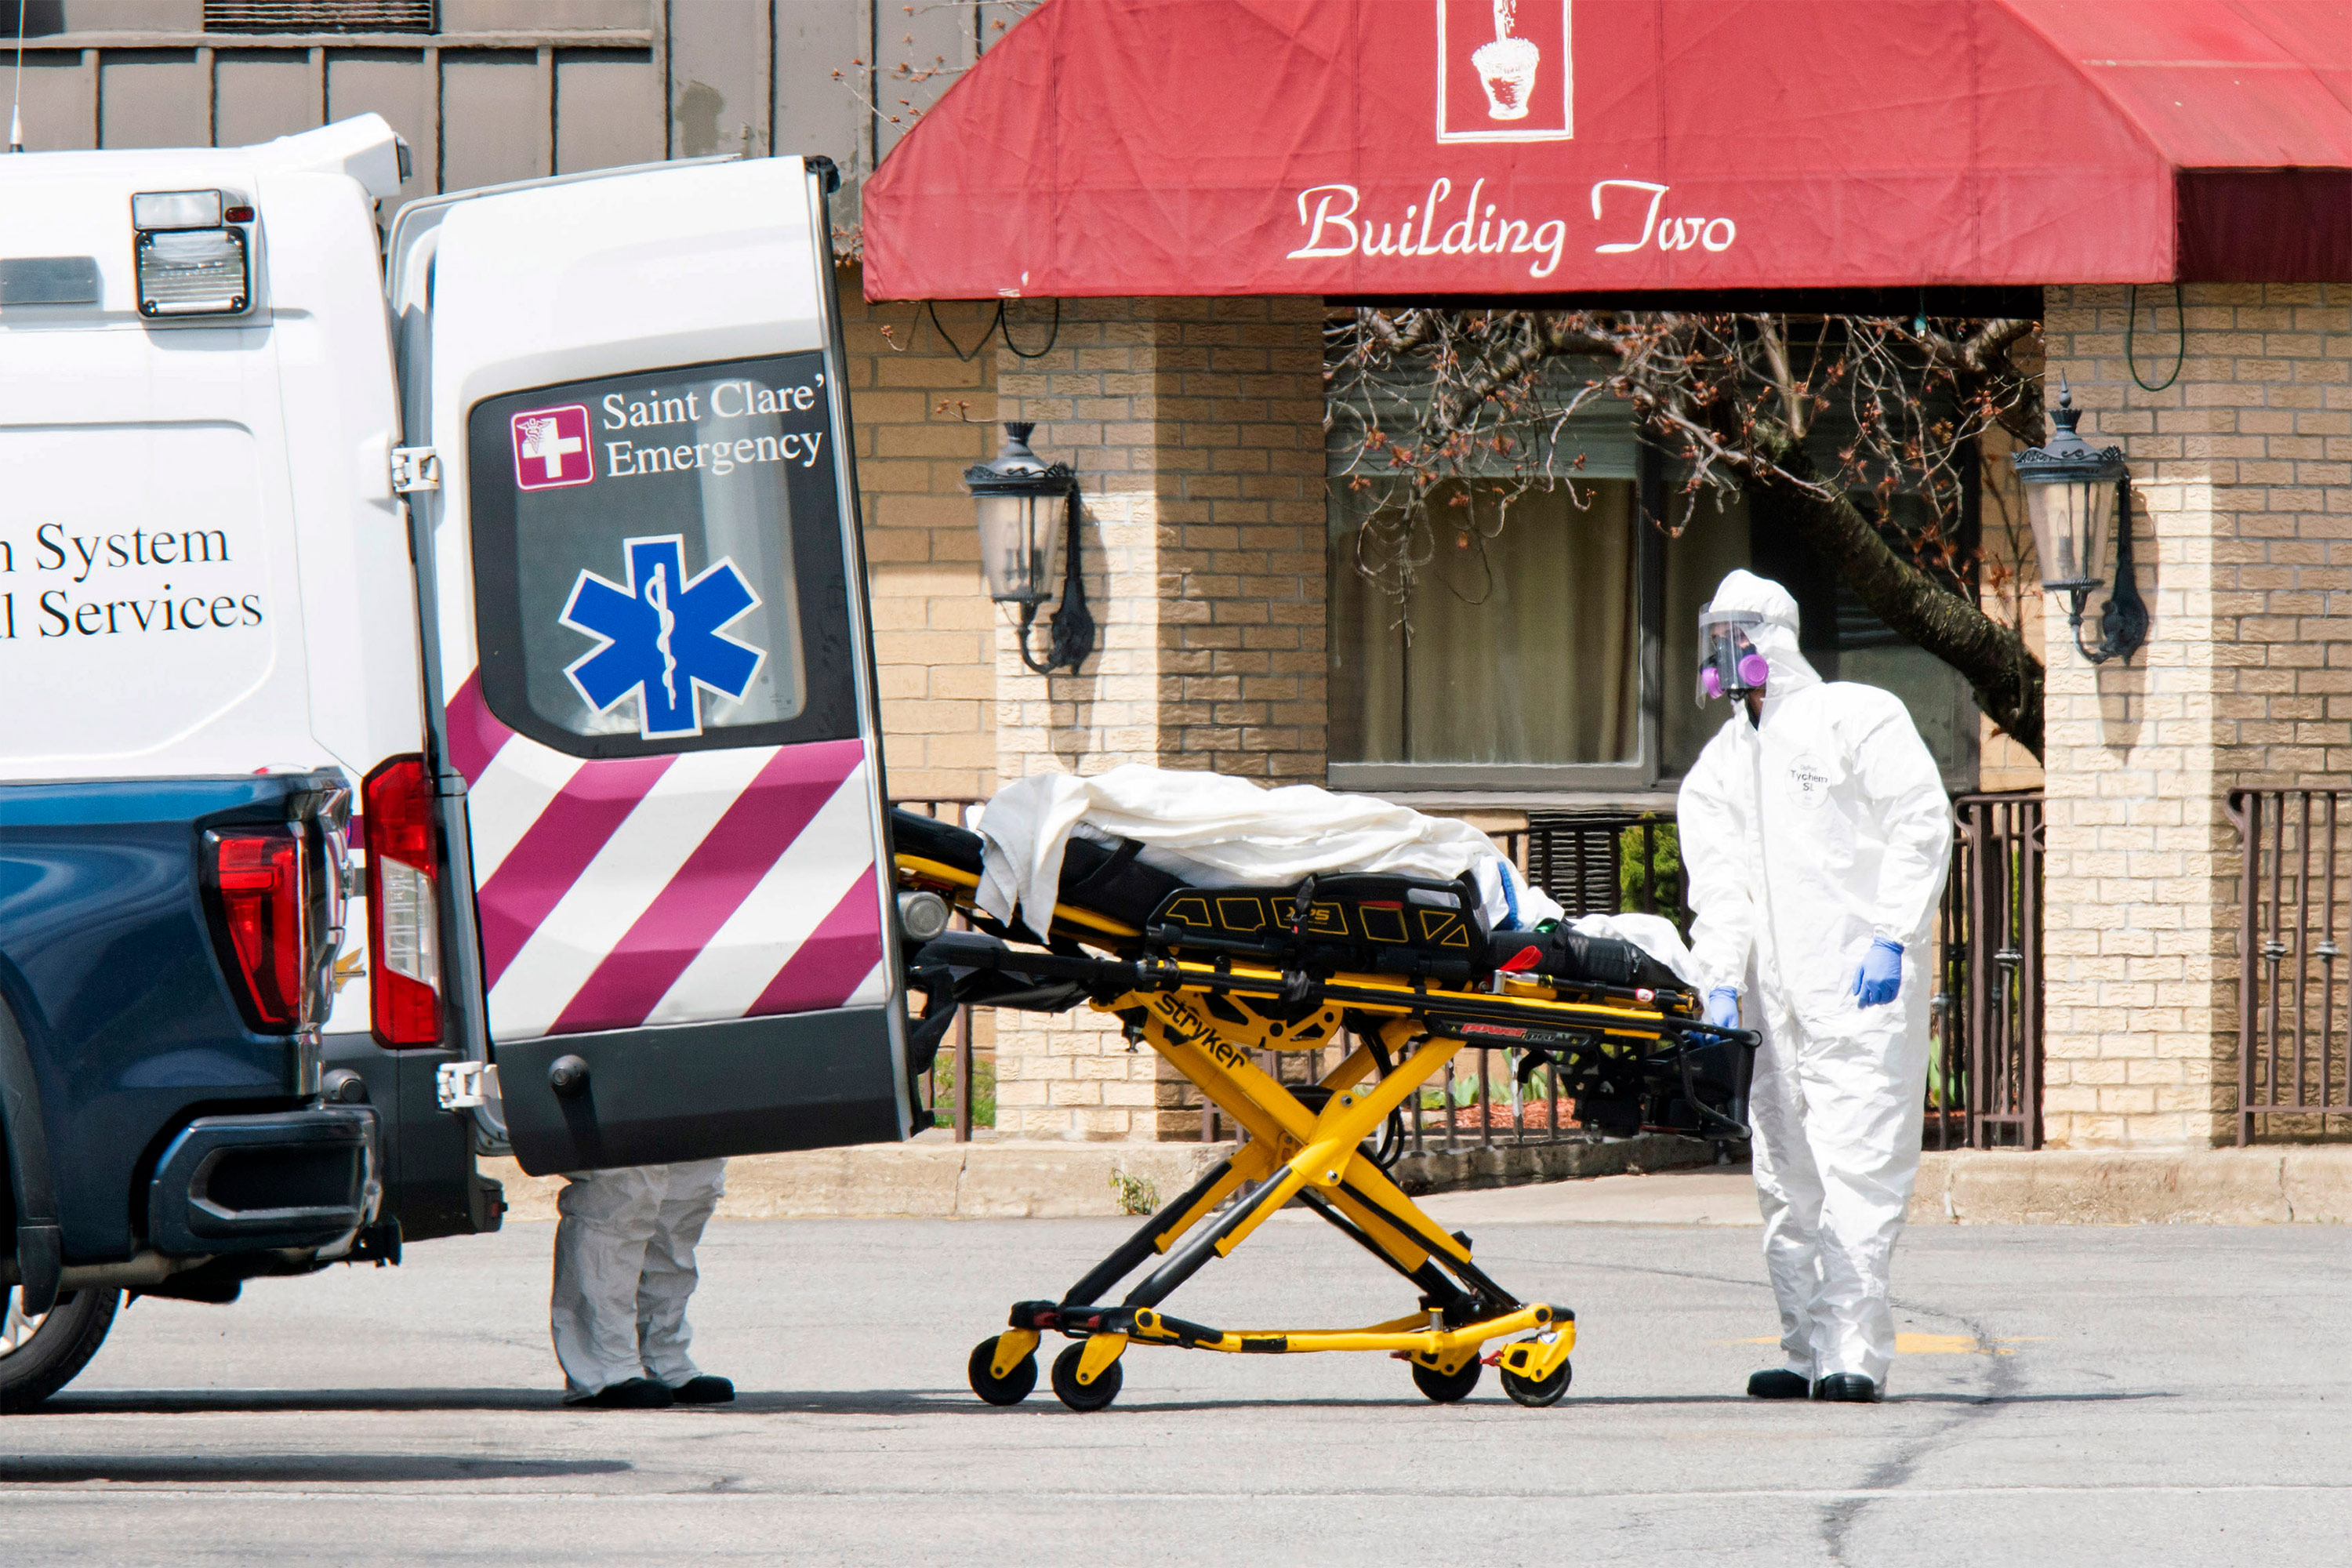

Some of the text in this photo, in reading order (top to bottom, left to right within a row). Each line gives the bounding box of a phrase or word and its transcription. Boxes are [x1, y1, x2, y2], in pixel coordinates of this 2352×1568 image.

[1287, 176, 1737, 278] Building Two
[602, 372, 825, 430] Saint Clare'
[604, 431, 823, 477] Emergency
[35, 522, 234, 583] System
[38, 583, 263, 638] Services
[1790, 770, 1828, 783] Tychem
[1154, 993, 1246, 1069] stryker
[1461, 1023, 1527, 1037] power
